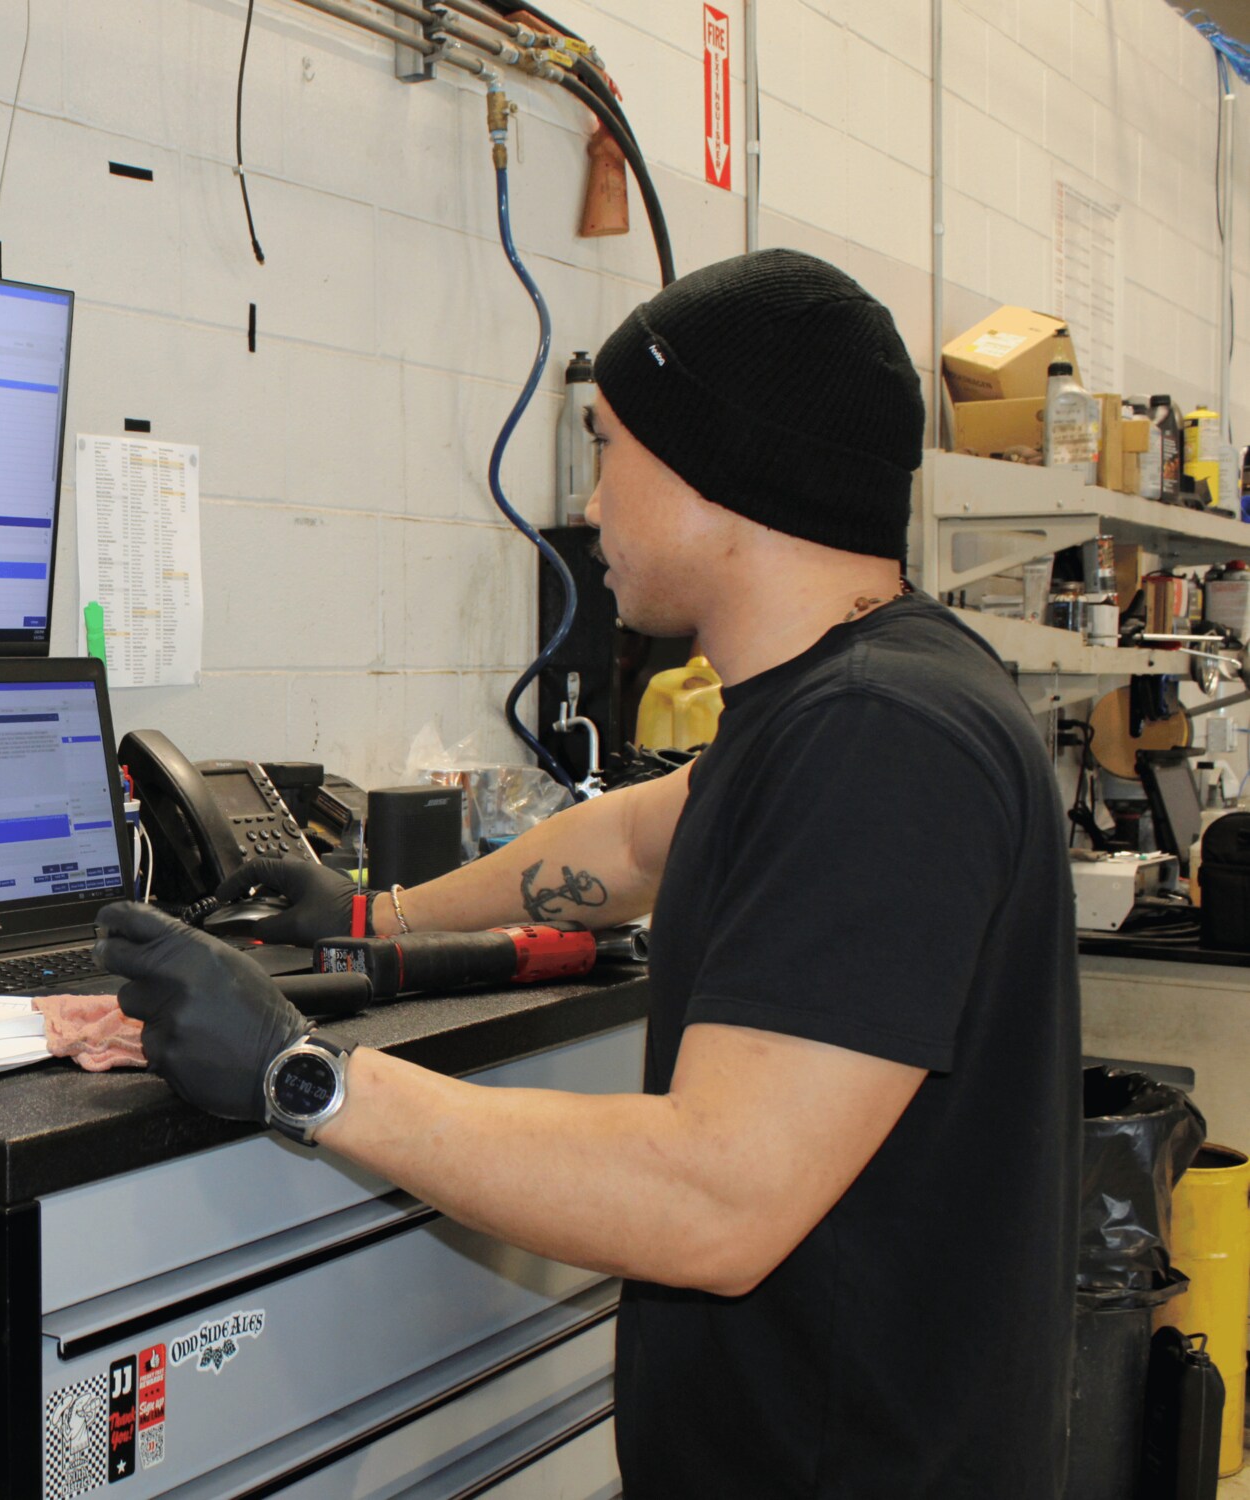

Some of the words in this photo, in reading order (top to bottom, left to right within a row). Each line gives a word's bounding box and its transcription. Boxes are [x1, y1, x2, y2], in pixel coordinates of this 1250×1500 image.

[708, 22, 725, 51] FIRE
[714, 53, 722, 170] EXTINGUISHER
[171, 1336, 200, 1363] ODD
[200, 1322, 230, 1348] SIDE
[230, 1312, 264, 1336] ALES
[112, 1365, 132, 1398] JJ
[109, 1405, 136, 1431] Thank
[140, 1401, 154, 1416] Sign
